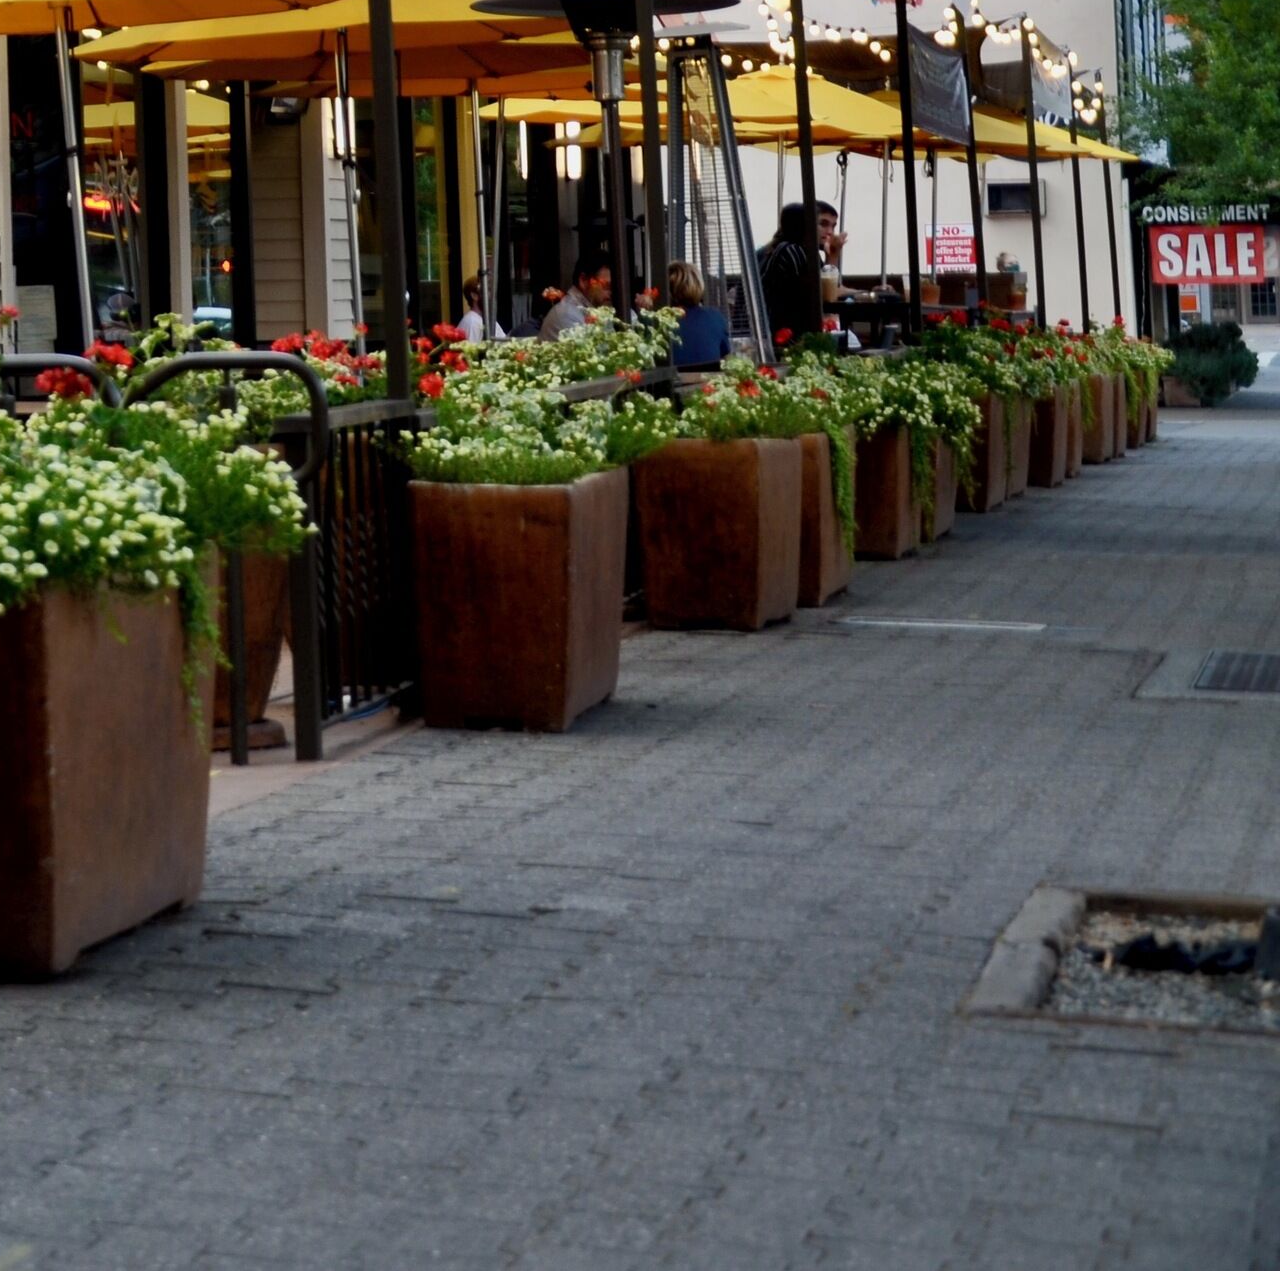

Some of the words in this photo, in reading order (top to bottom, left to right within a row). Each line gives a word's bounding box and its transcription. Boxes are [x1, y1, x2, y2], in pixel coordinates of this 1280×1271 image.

[1142, 204, 1270, 223] CONSIGMENT
[942, 226, 960, 236] NO
[935, 239, 971, 247] estaurant
[935, 247, 953, 256] offee
[1157, 232, 1258, 278] SALE
